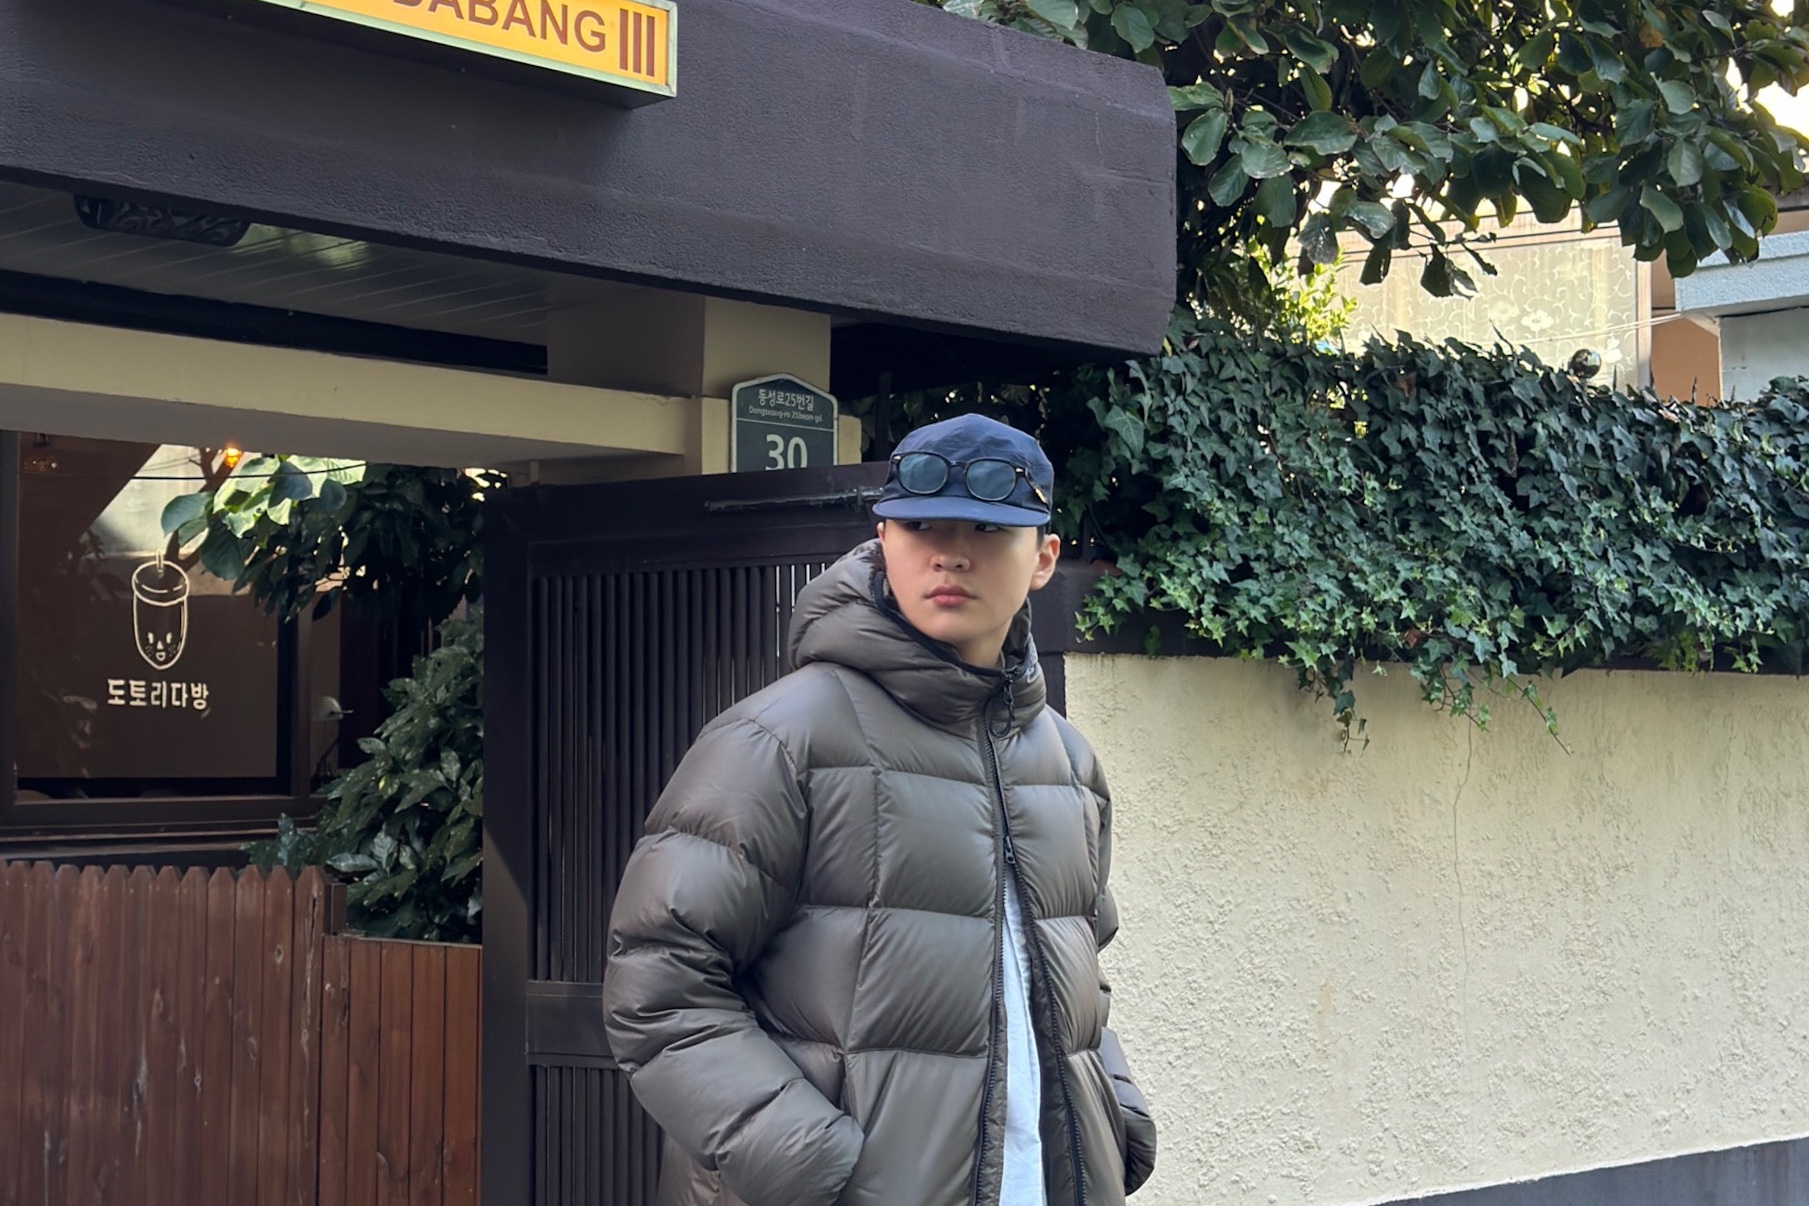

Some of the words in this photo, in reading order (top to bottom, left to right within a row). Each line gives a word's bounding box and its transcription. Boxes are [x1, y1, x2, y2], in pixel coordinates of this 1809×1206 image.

[393, 0, 607, 53] BANG
[758, 389, 814, 411] 동성로25번길
[765, 433, 808, 471] 30
[107, 679, 209, 710] 도토리다방
